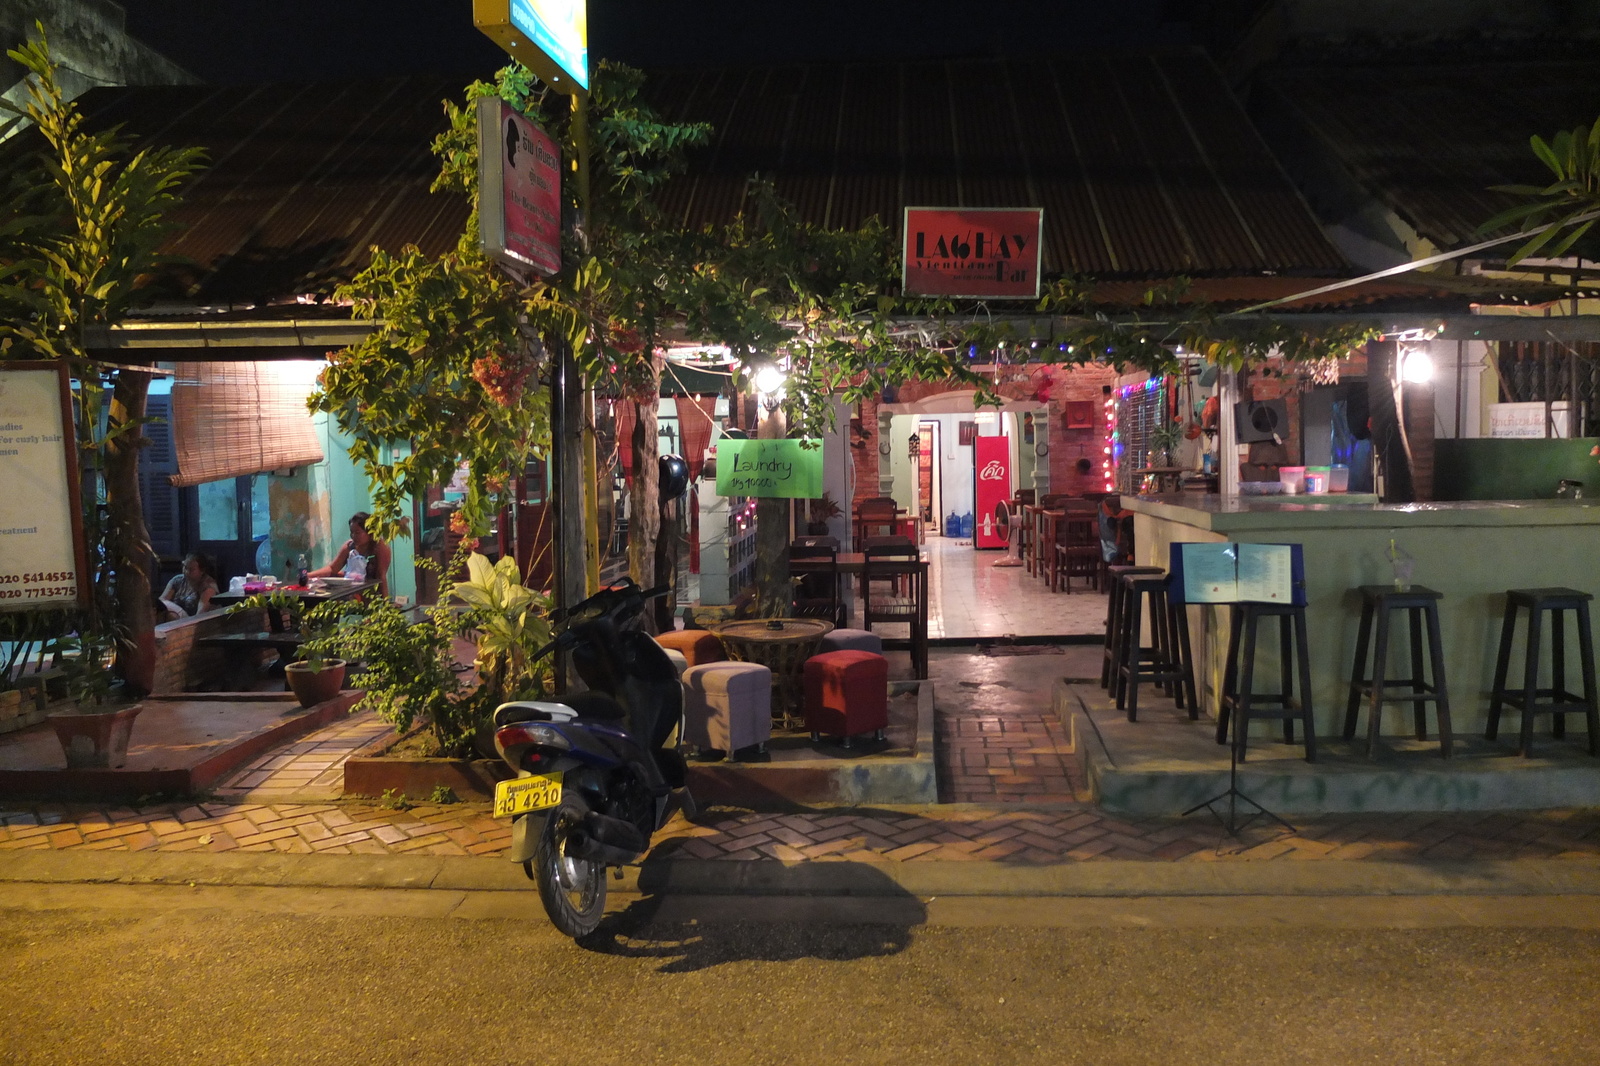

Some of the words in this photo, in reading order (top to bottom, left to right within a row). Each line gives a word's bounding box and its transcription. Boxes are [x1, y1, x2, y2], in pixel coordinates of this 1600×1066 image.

[41, 434, 62, 442] hair
[733, 453, 792, 481] Laundry
[23, 571, 74, 584] 5414552
[0, 589, 22, 599] 020
[25, 586, 77, 598] 7713275
[523, 788, 559, 808] 4210
